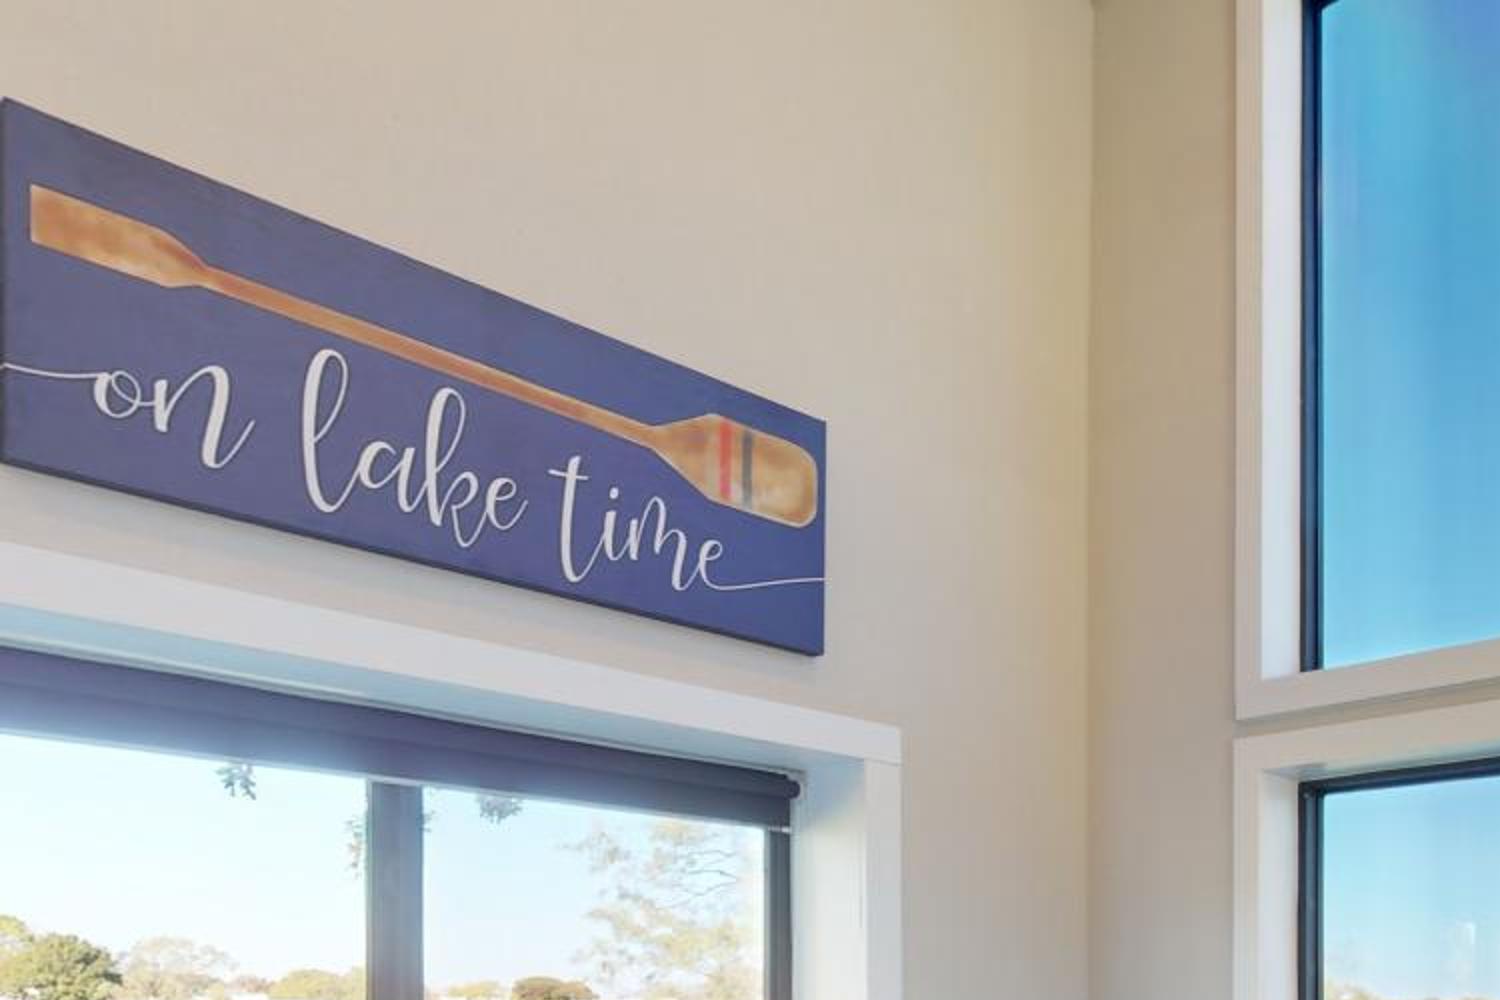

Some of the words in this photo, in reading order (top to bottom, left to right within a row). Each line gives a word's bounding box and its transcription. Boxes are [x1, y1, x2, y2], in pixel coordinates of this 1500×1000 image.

[92, 363, 257, 470] on
[300, 348, 529, 549] lake
[547, 454, 735, 592] time
